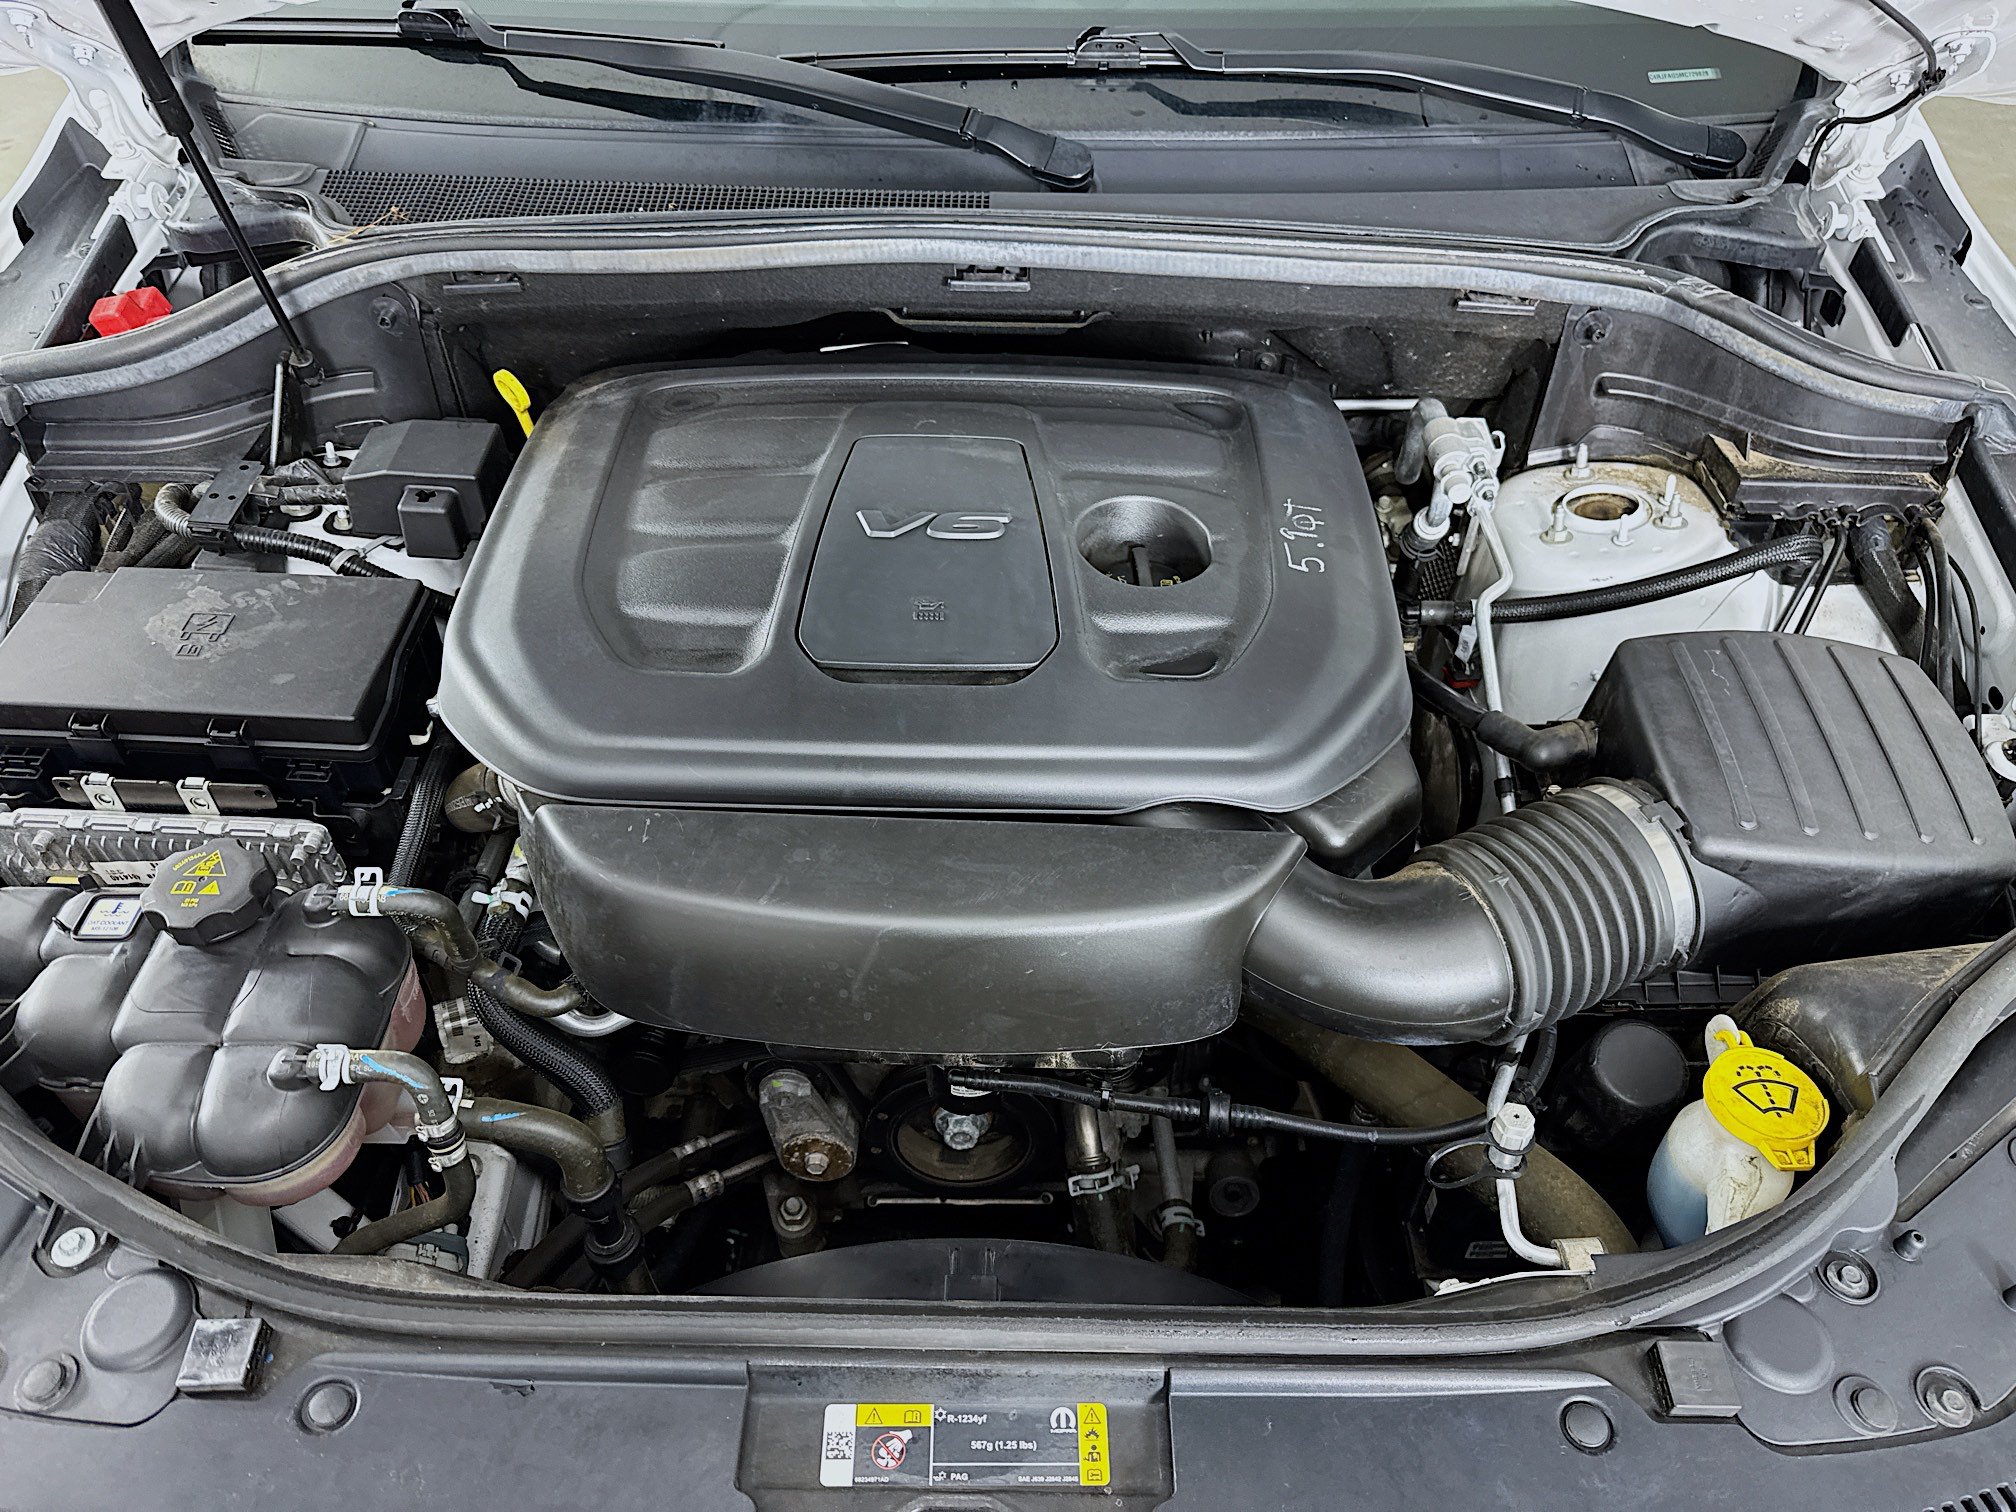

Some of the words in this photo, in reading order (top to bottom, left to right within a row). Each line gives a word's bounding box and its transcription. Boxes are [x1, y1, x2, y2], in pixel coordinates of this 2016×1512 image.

[856, 510, 1013, 540] V6
[947, 1414, 988, 1425] R-1234yf
[971, 1440, 994, 1451] 567g
[995, 1440, 1018, 1451] (1.25
[1019, 1440, 1038, 1451] lbs)
[950, 1472, 969, 1481] PAG
